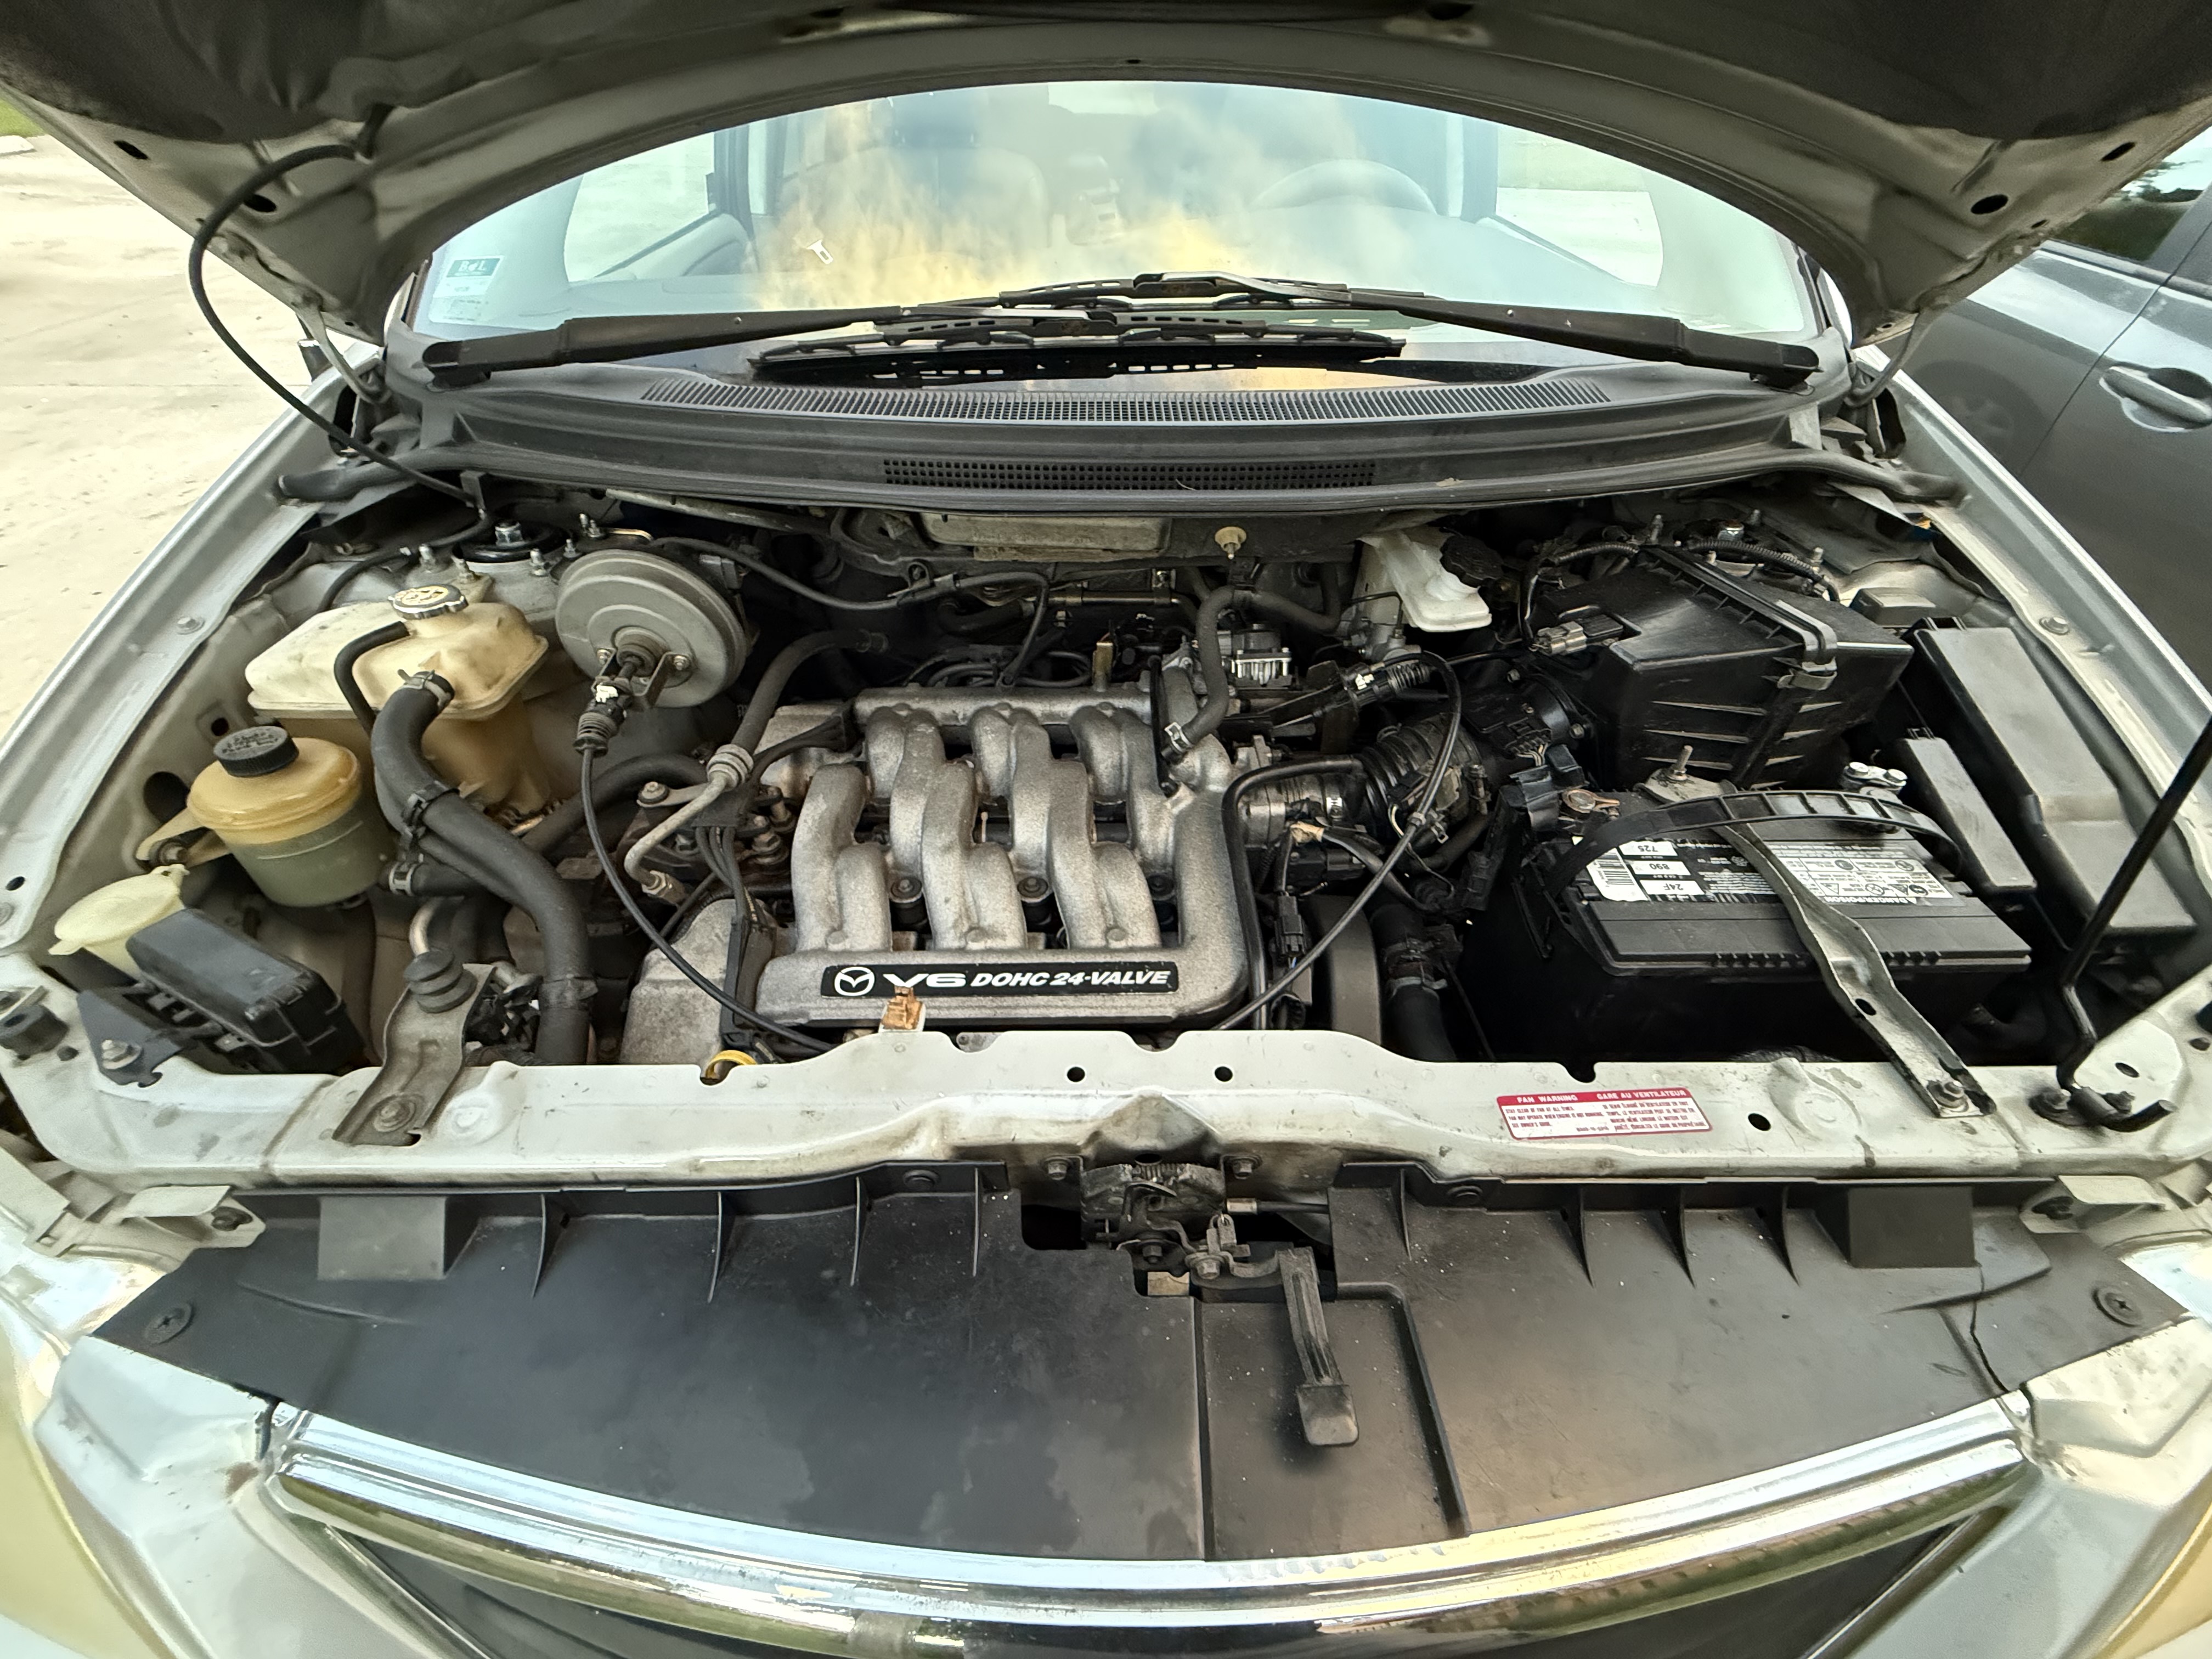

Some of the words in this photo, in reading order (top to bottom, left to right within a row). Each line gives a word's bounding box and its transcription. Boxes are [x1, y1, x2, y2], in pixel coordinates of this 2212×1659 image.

[1663, 883, 1684, 891] 24F
[883, 973, 966, 988] V6
[970, 972, 1049, 988] DOHC
[1049, 970, 1171, 986] 24-VALVE
[1633, 1090, 1686, 1098] VENTILATEUR
